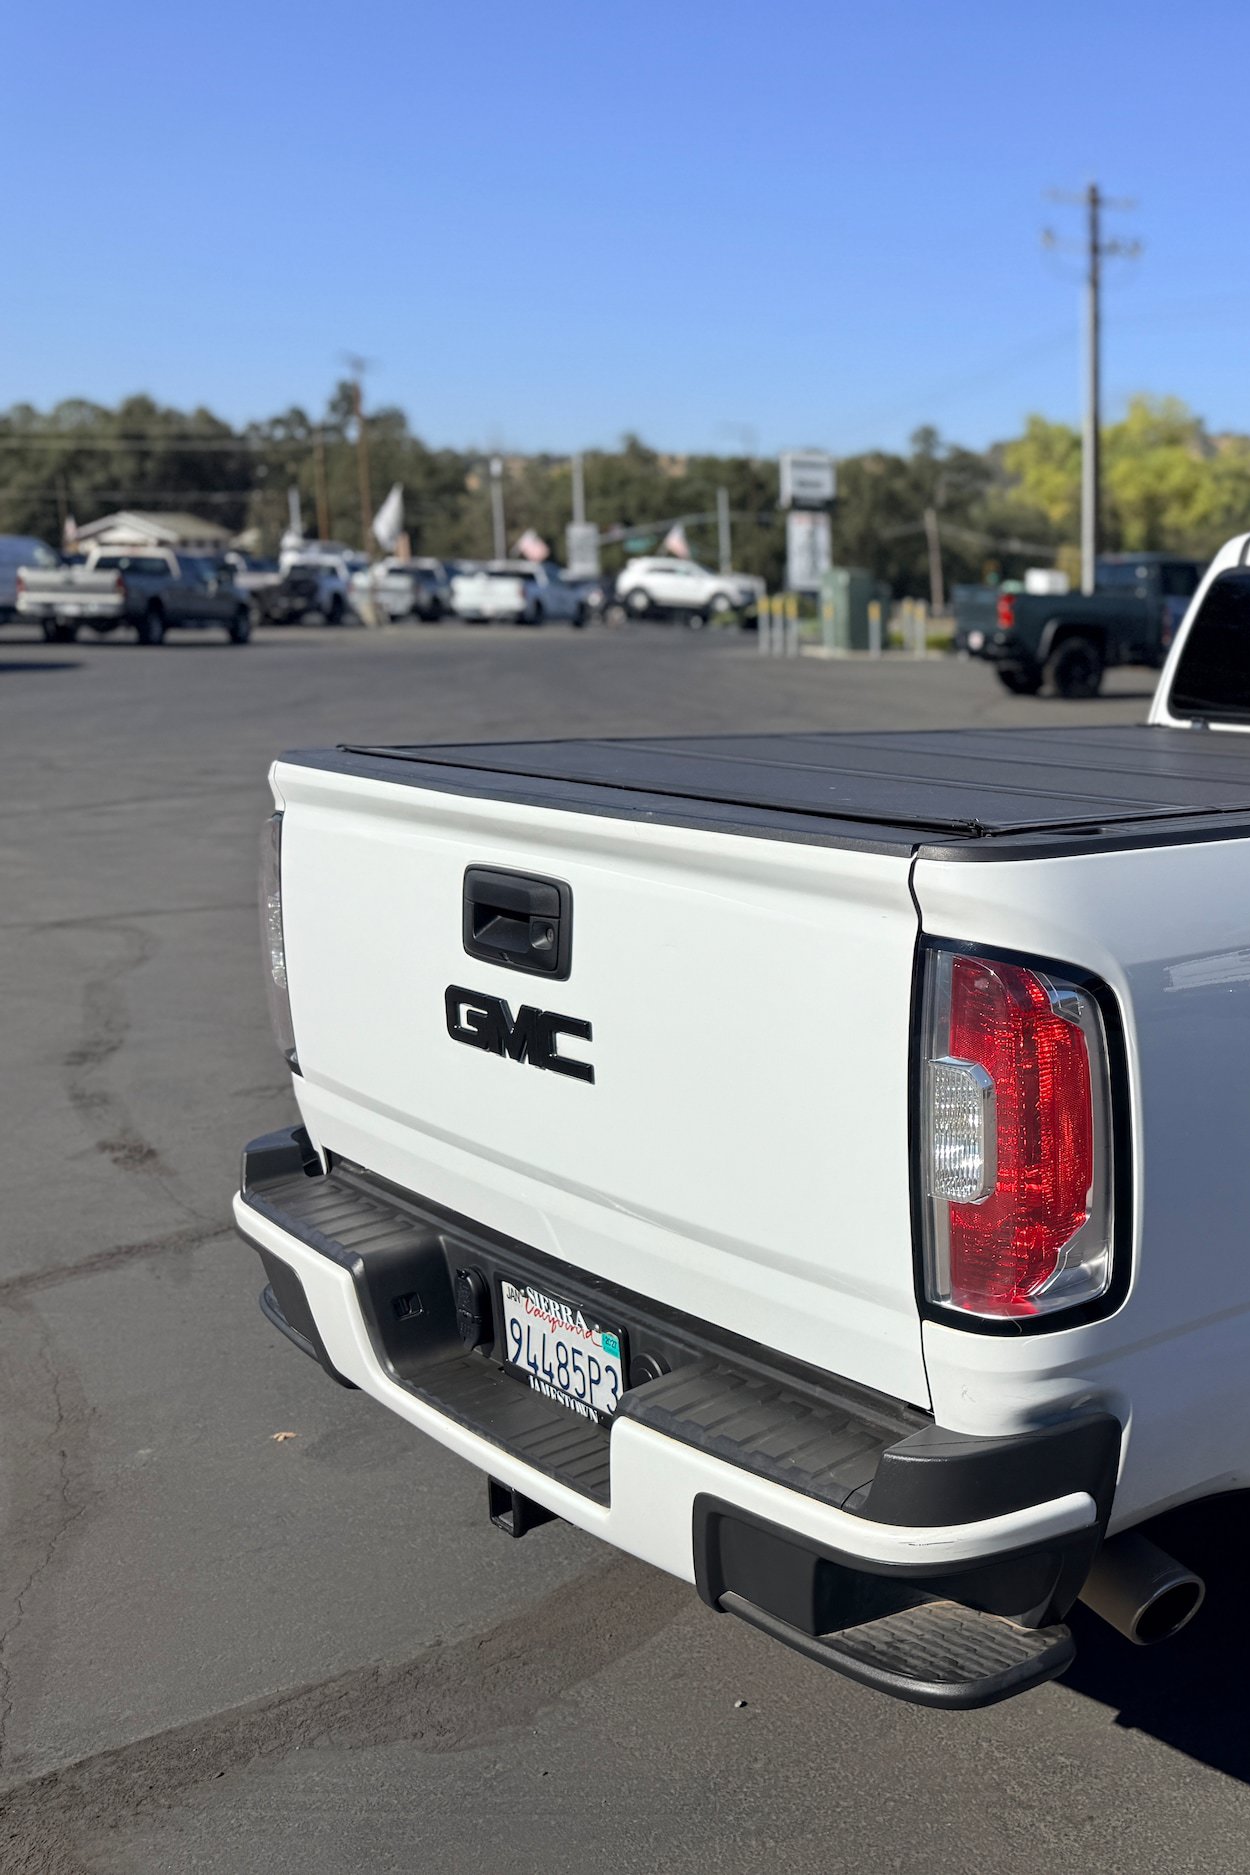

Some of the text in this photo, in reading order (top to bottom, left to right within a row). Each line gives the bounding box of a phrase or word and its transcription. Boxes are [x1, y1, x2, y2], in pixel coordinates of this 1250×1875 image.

[445, 984, 595, 1085] GMC
[506, 1286, 521, 1303] JAN
[526, 1286, 588, 1330] SIERRA
[510, 1317, 618, 1416] 94485P3
[529, 1374, 598, 1423] JAMESTOWN
